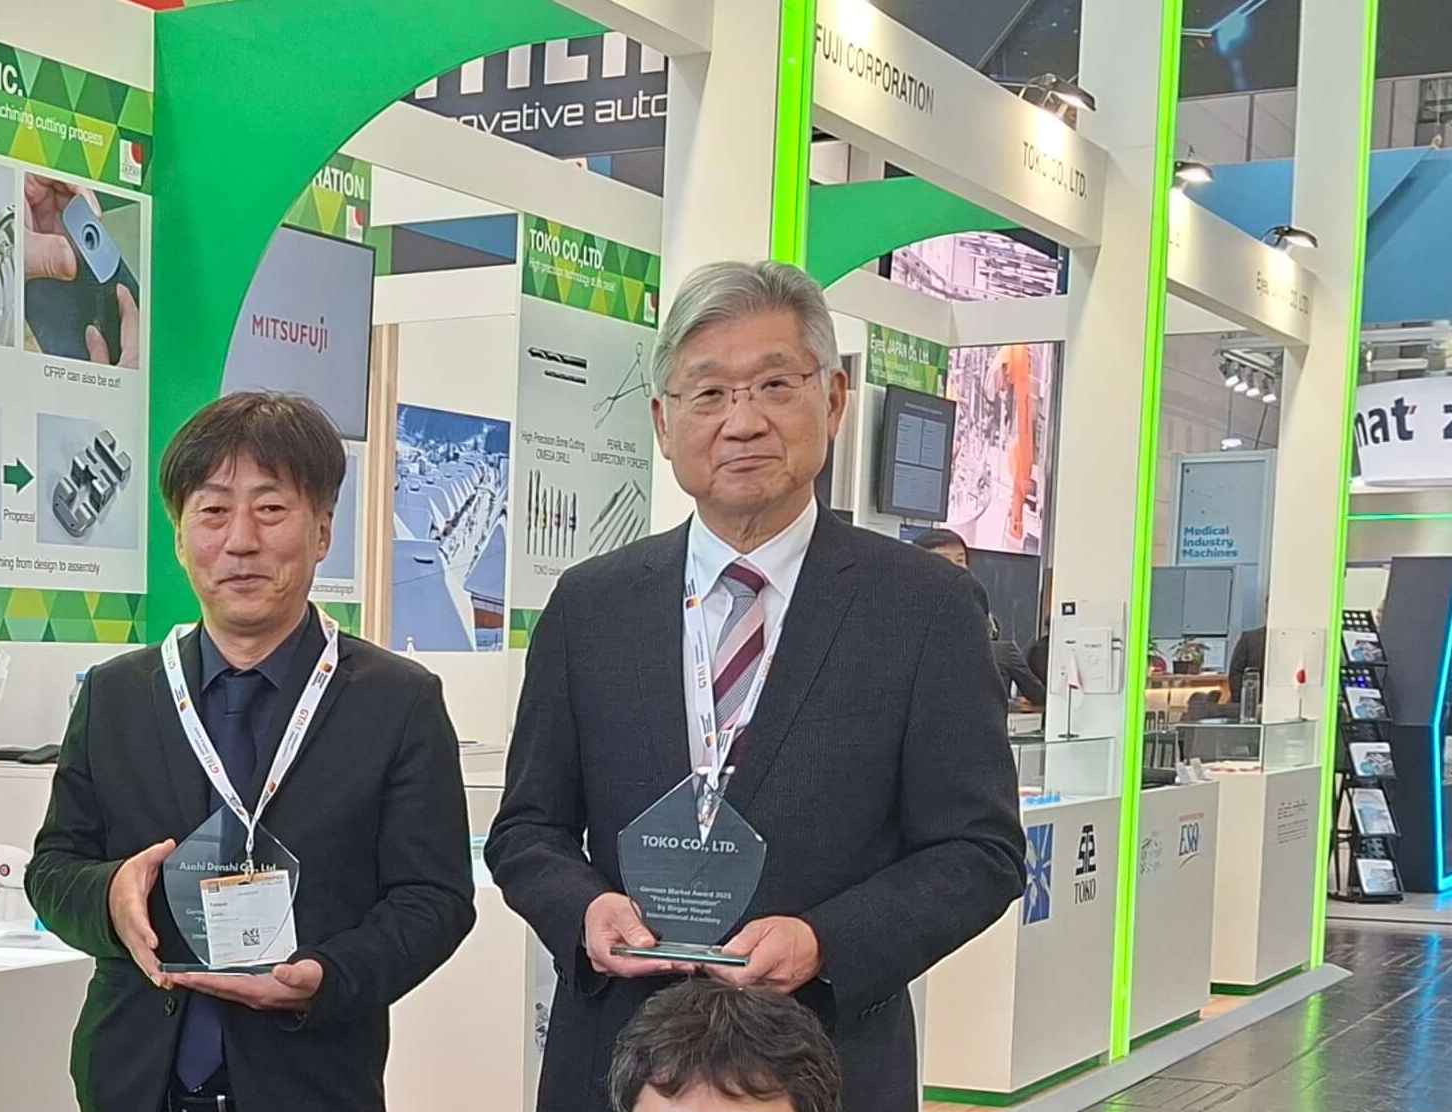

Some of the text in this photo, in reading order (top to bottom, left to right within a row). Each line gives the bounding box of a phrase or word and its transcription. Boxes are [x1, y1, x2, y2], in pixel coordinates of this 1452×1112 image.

[847, 42, 935, 116] CORPORATION
[448, 101, 584, 134] ovative
[35, 110, 67, 139] cutting
[68, 126, 104, 147] process
[529, 228, 561, 257] TOKO
[43, 365, 65, 379] CFRP
[67, 370, 80, 382] can
[81, 372, 97, 385] also
[97, 376, 107, 387] be
[3, 508, 36, 524] Proposal
[1183, 524, 1230, 536] Medical
[1183, 536, 1235, 549] Industry
[1181, 547, 1239, 558] Machines
[15, 556, 33, 570] from
[33, 558, 58, 573] design
[59, 560, 67, 571] to
[67, 561, 101, 576] assembly
[641, 834, 679, 849] TOKO
[711, 840, 740, 853] LTD.
[179, 862, 206, 872] Asahi
[208, 862, 239, 872] Denshi
[639, 886, 667, 894] German
[668, 887, 691, 896] Market
[692, 889, 714, 898] Award
[1074, 877, 1097, 905] TOKO
